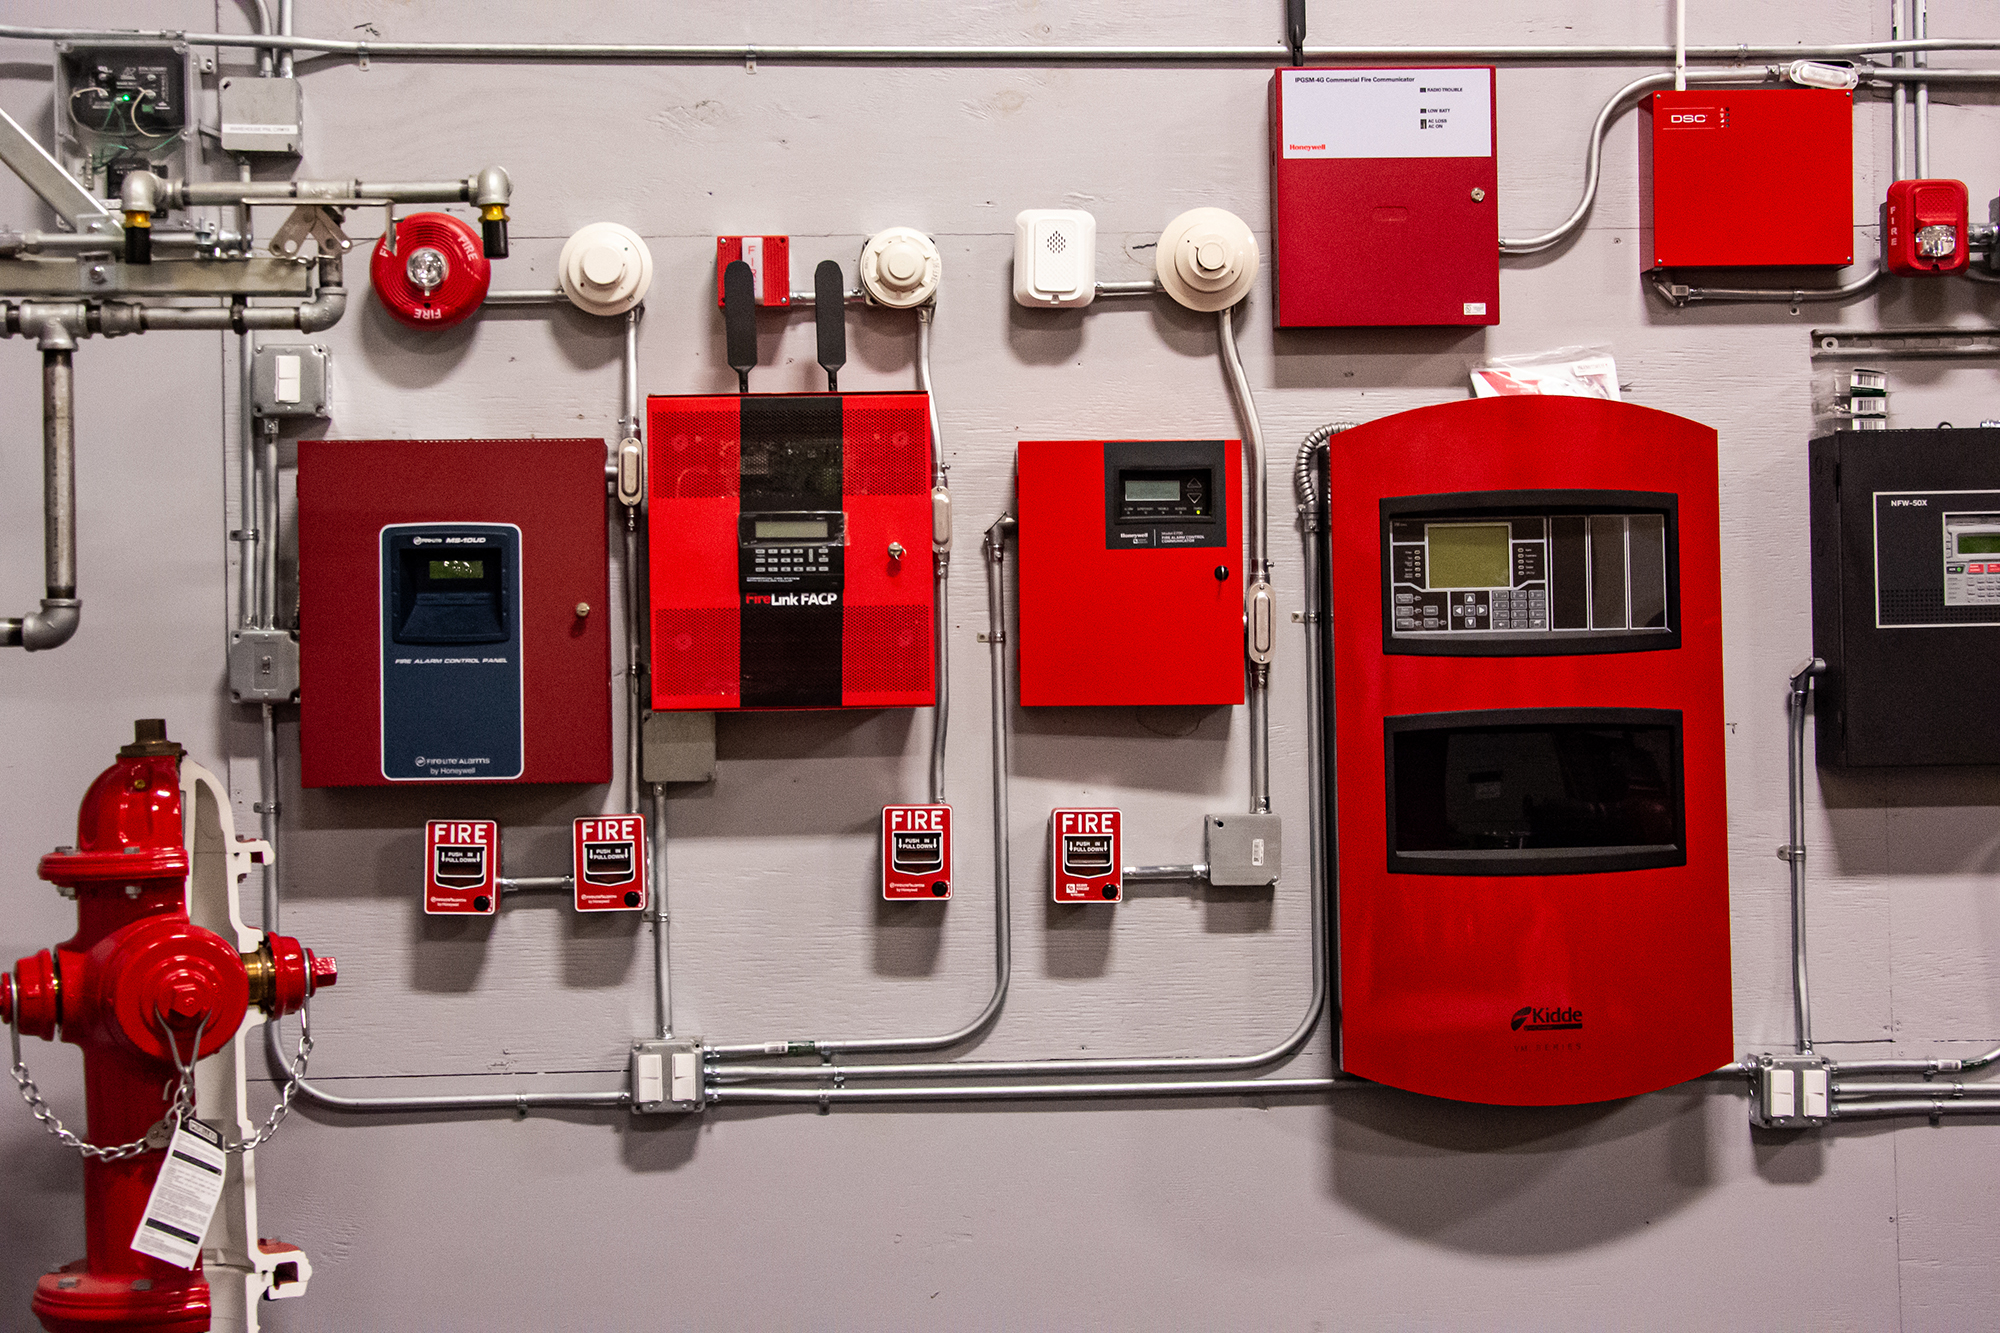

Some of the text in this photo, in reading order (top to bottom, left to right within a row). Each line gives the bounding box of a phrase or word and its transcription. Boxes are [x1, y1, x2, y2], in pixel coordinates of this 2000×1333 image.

[1670, 114, 1706, 124] DSC
[1290, 144, 1326, 152] Honeywell
[458, 234, 478, 262] FIRE
[414, 308, 442, 320] FIRE
[746, 592, 838, 606] FireLink FACP
[430, 767, 476, 775] by Honeywell
[892, 810, 943, 830] FIRE
[1062, 814, 1114, 833] FIRE
[434, 824, 487, 843] FIRE
[582, 820, 635, 840] FIRE
[1532, 1006, 1583, 1023] Kidde
